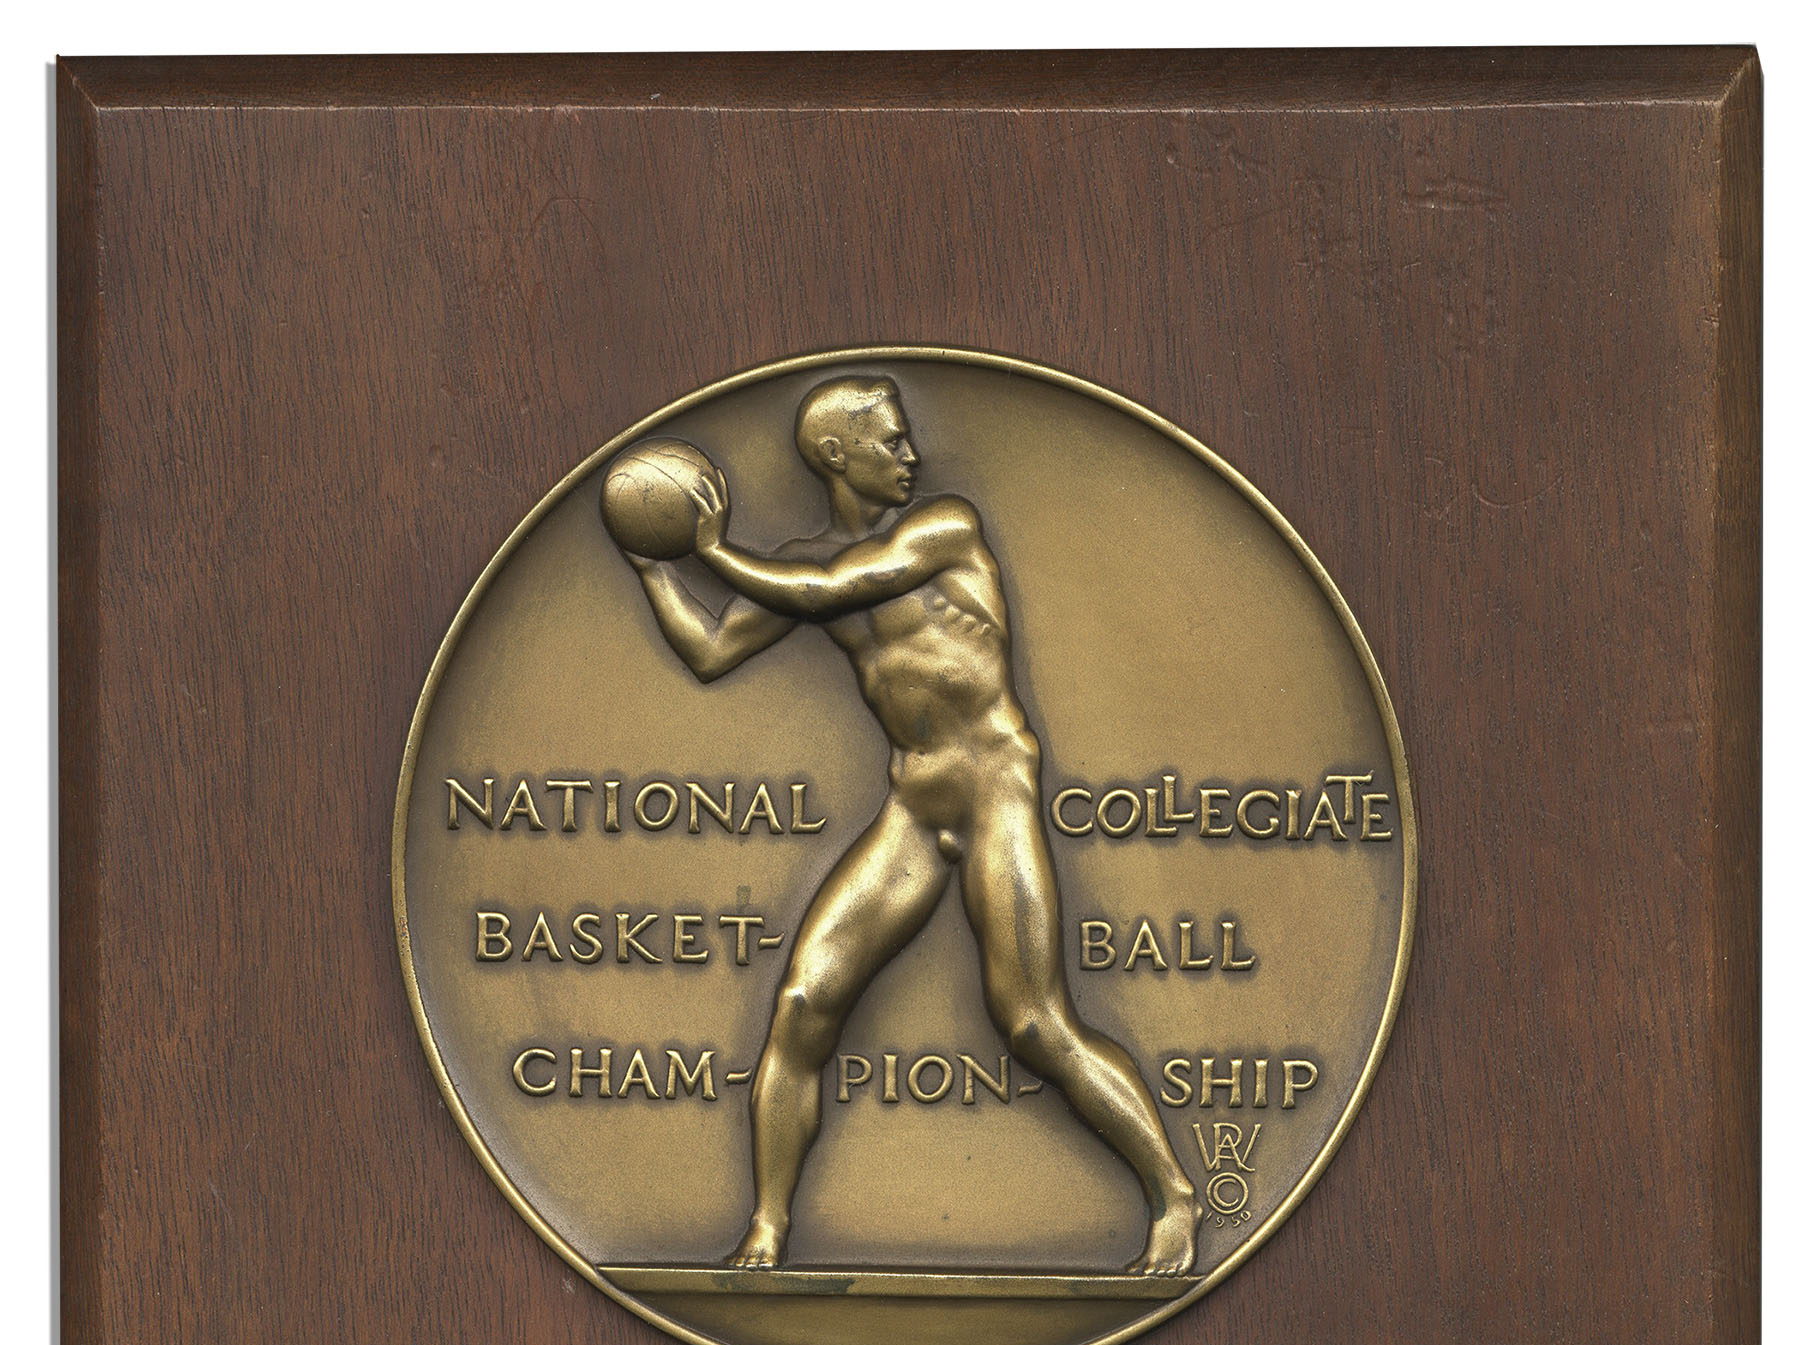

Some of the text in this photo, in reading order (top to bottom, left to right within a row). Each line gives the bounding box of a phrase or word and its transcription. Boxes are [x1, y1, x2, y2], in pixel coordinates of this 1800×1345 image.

[445, 771, 1393, 841] NATIONAL COLLEGIATE
[475, 911, 1256, 971] BASKET- BALL
[512, 1048, 1319, 1109] CHAM- PION- SHIP
